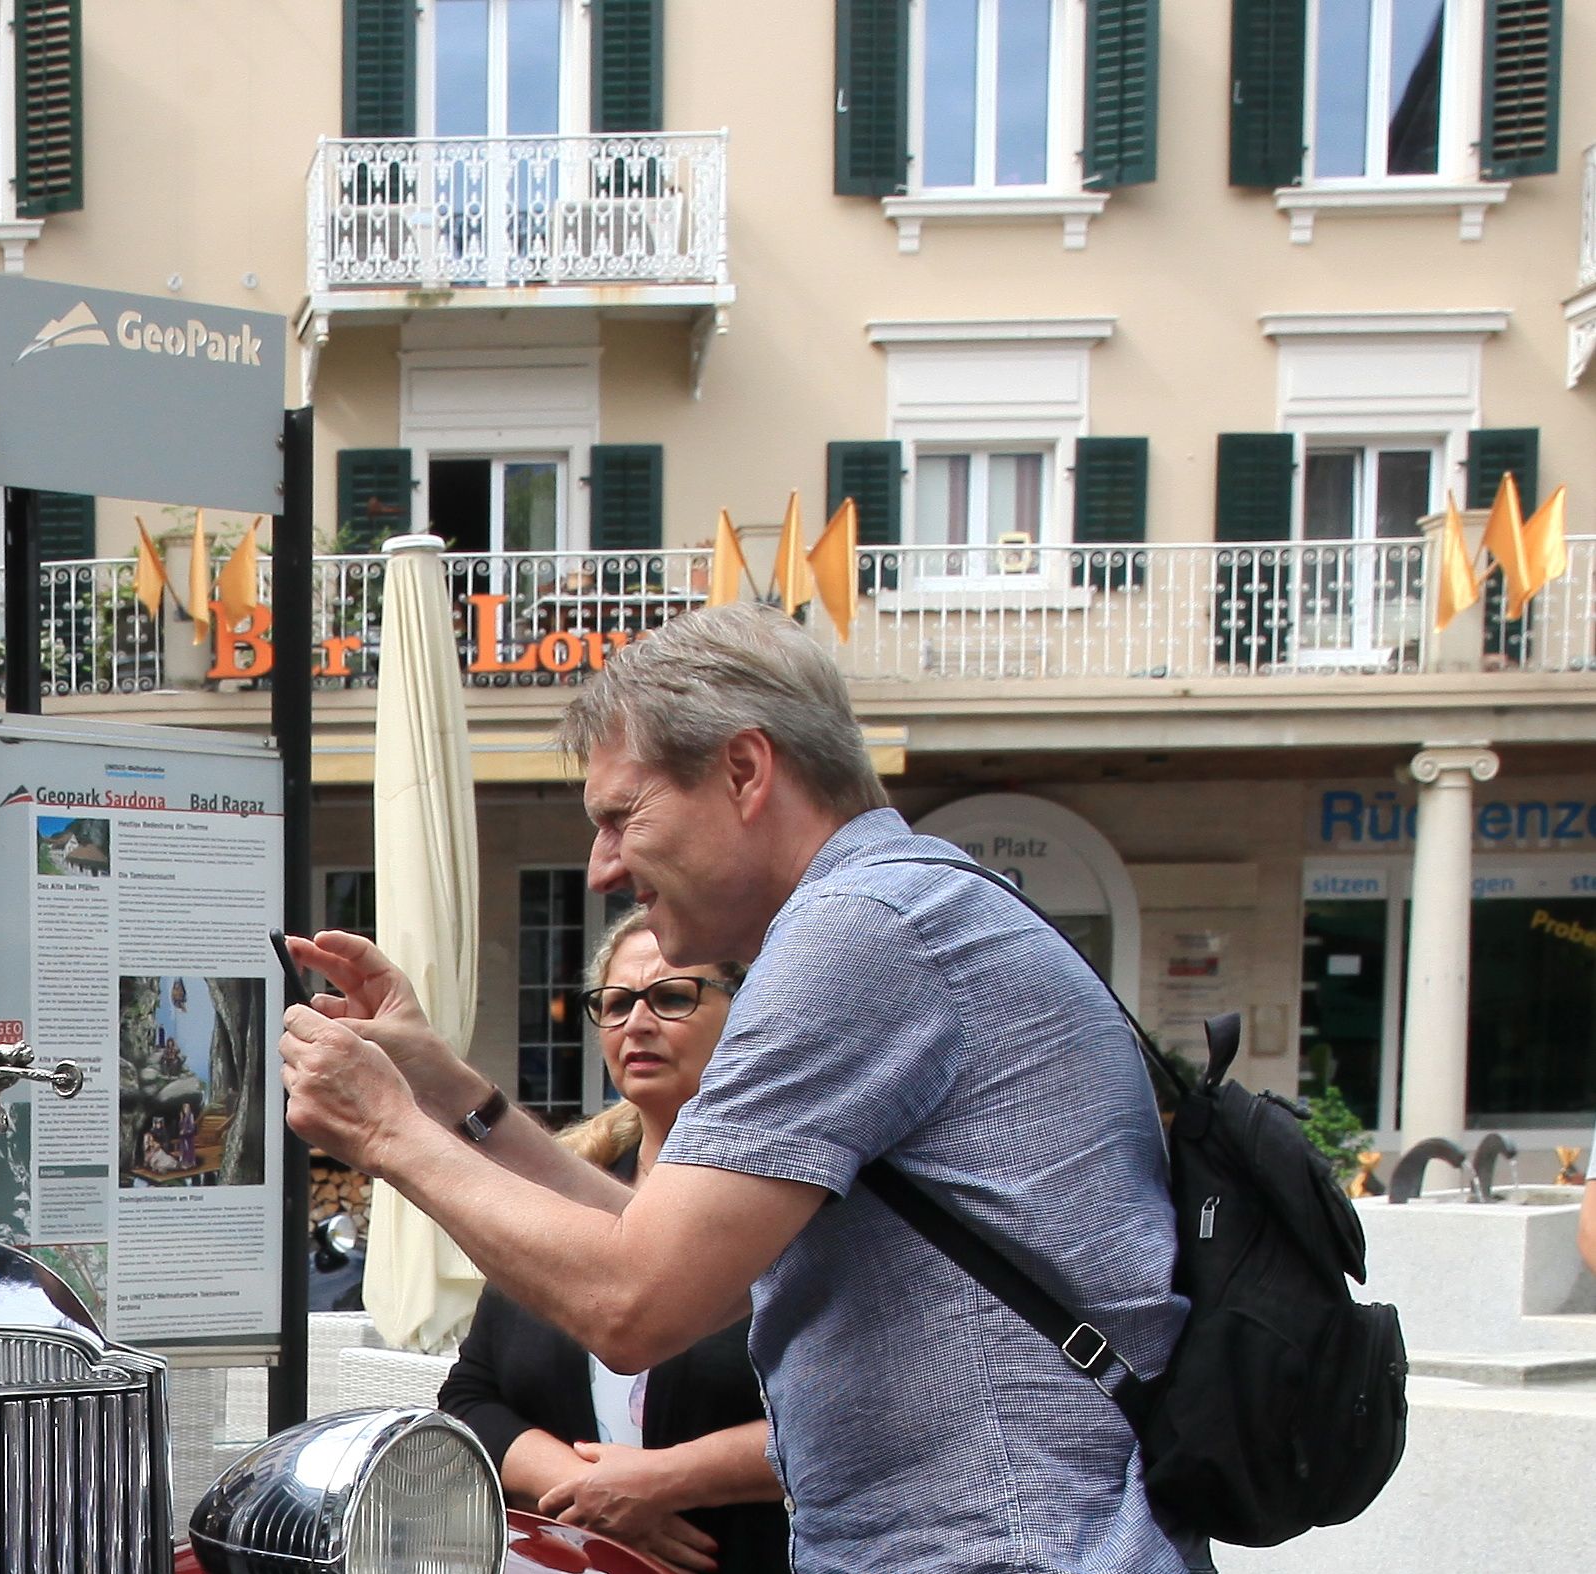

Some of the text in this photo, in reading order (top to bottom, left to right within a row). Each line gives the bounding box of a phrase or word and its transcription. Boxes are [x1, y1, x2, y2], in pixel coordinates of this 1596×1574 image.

[116, 310, 261, 366] GeoPark
[208, 601, 363, 679] Br
[37, 786, 264, 817] Geopark Sardona Bad Ragaz
[994, 837, 1047, 857] Platz
[1313, 876, 1379, 893] sitzen
